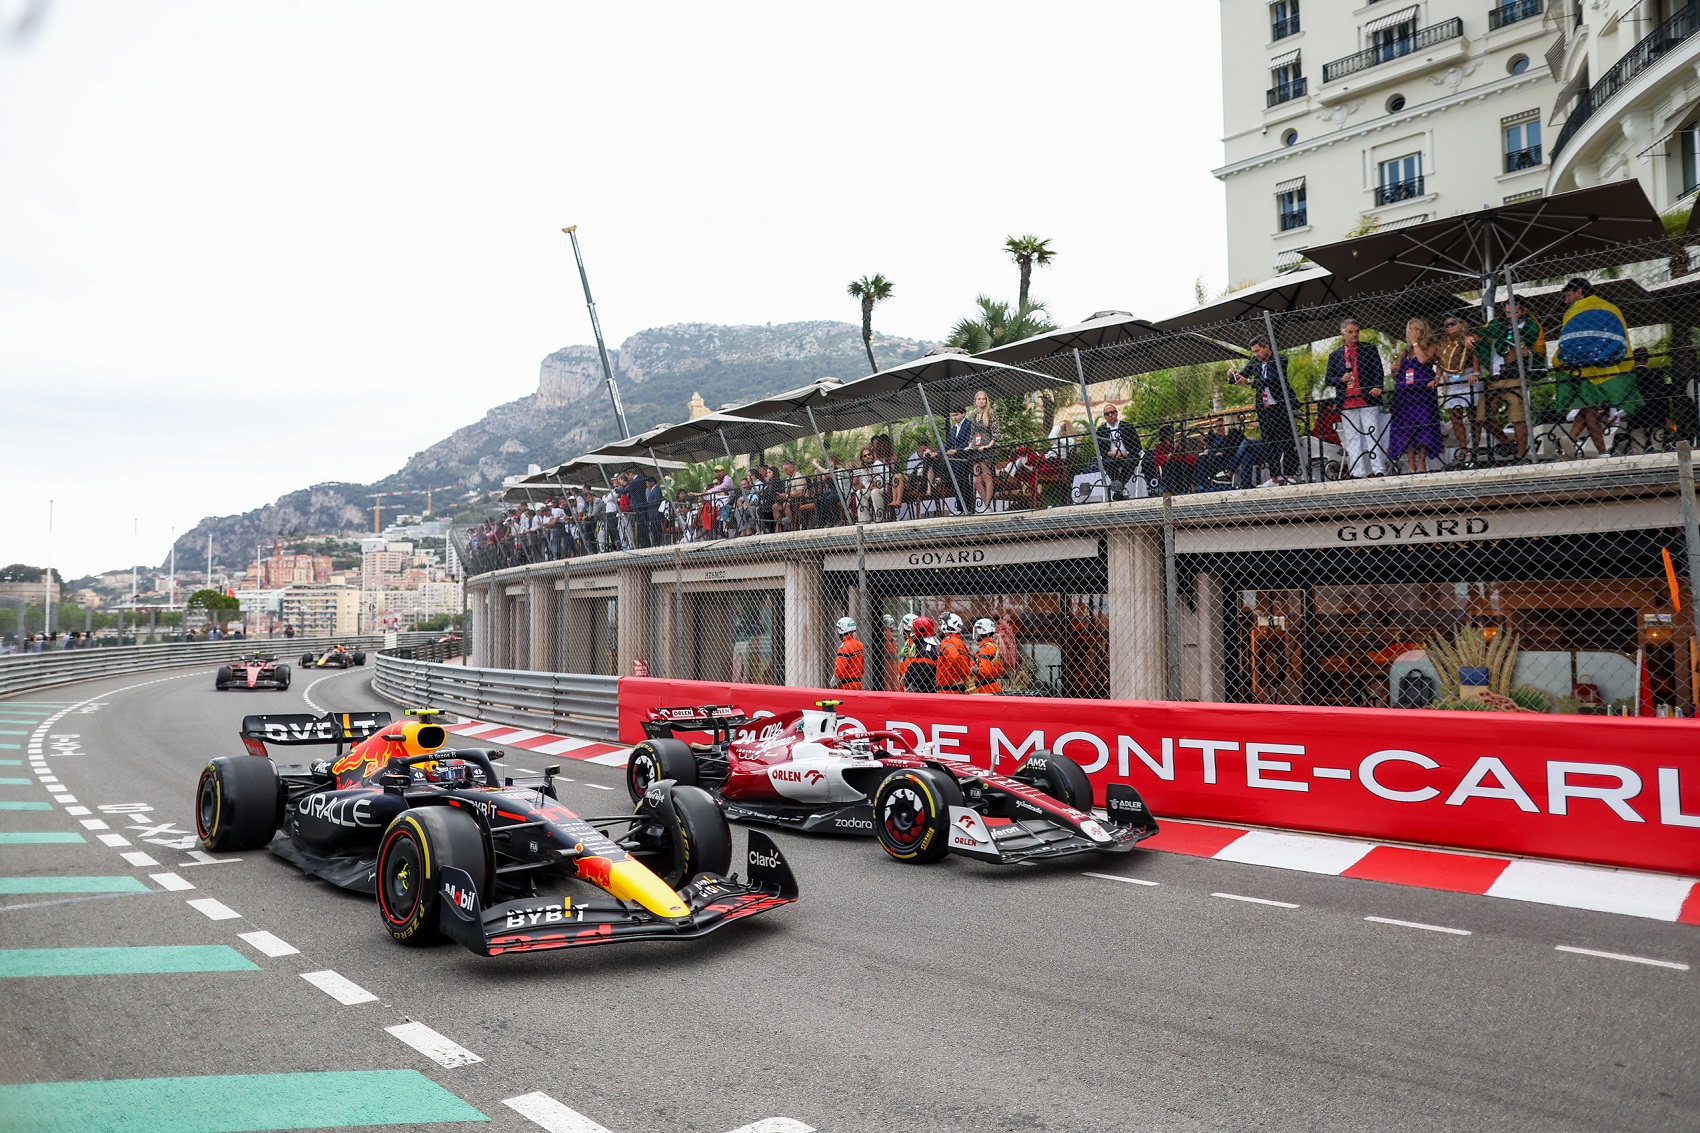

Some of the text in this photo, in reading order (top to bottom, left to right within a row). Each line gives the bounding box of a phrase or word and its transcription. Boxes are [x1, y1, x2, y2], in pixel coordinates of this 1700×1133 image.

[1337, 517, 1489, 542] GOYARD
[908, 549, 985, 565] GOYARD
[731, 729, 756, 745] 24
[759, 721, 785, 742] Alfa
[885, 720, 971, 763] DE
[1026, 757, 1048, 768] AMX
[772, 769, 802, 782] ORLEN
[299, 793, 382, 828] ORACLE
[469, 799, 498, 820] YBIT
[1119, 799, 1142, 808] ADLER
[835, 817, 873, 830] zadara
[954, 836, 977, 847] ORLEN
[748, 850, 777, 869] Claro
[445, 882, 476, 912] Mobil
[506, 895, 589, 929] BYBIT
